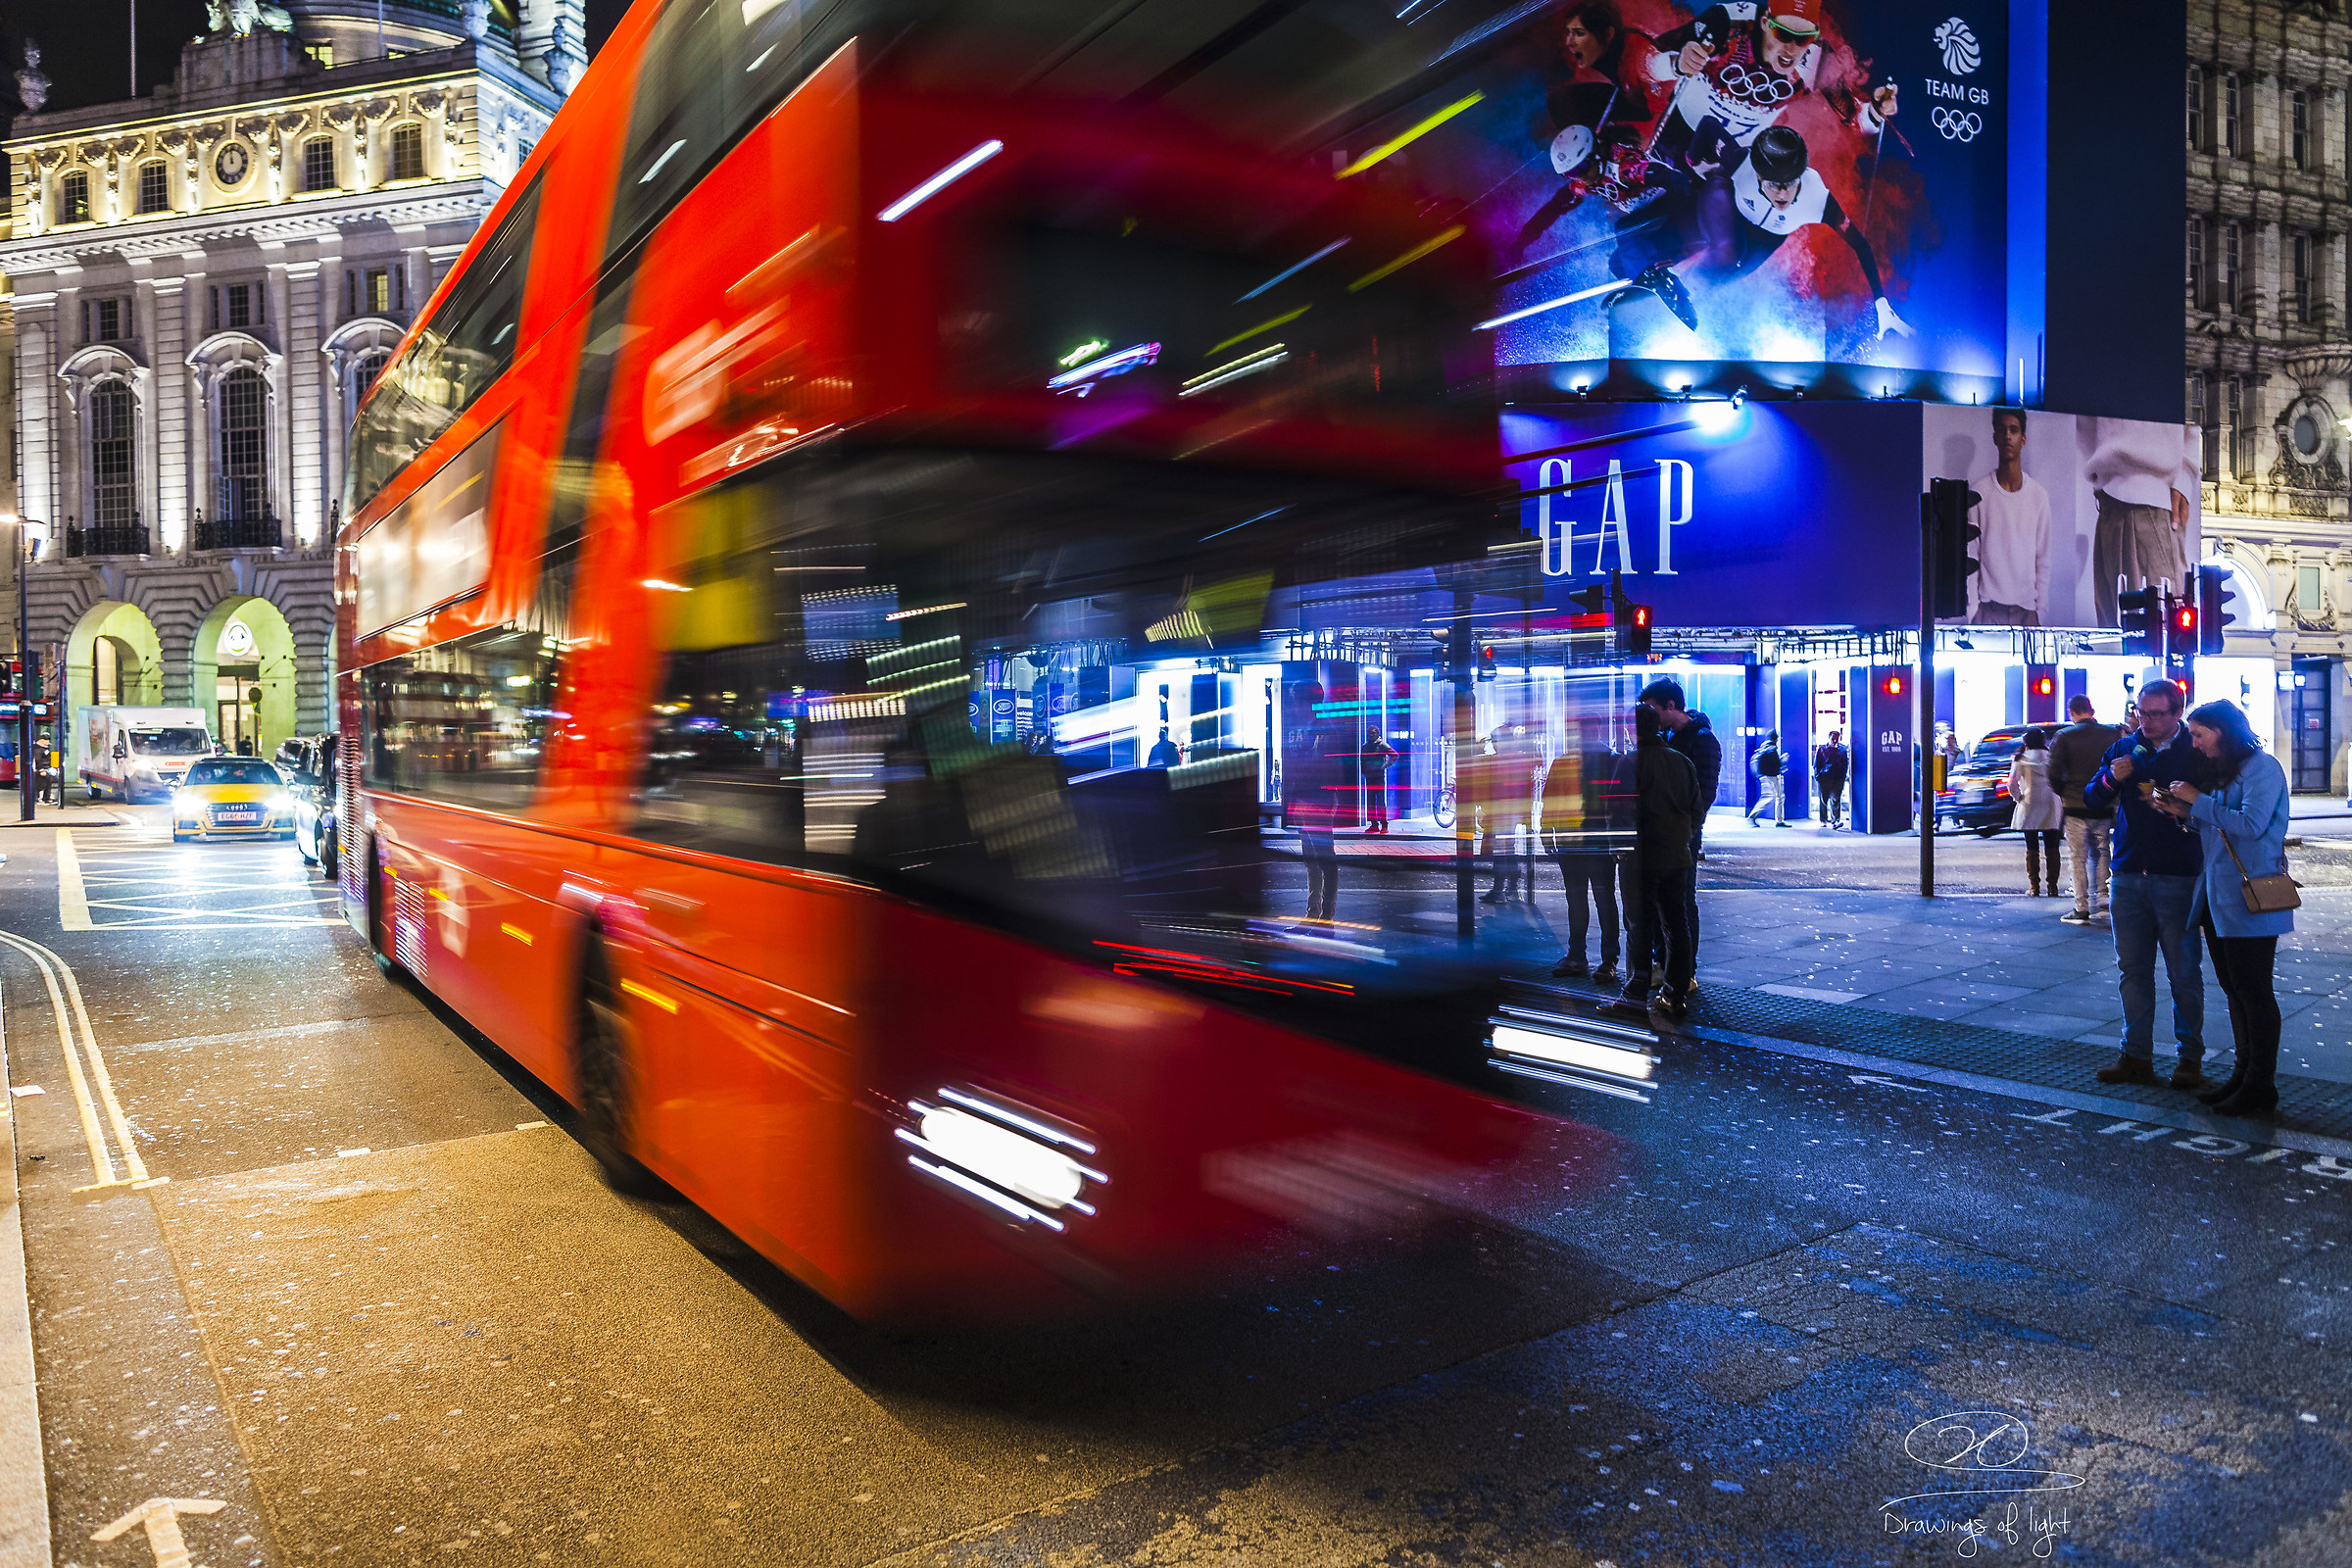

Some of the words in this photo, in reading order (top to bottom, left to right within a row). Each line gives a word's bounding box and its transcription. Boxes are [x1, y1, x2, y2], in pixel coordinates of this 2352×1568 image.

[1925, 78, 1964, 101] TEAM
[1968, 87, 1989, 105] GB
[1539, 458, 1693, 576] GAP
[1882, 730, 1902, 746] GAP
